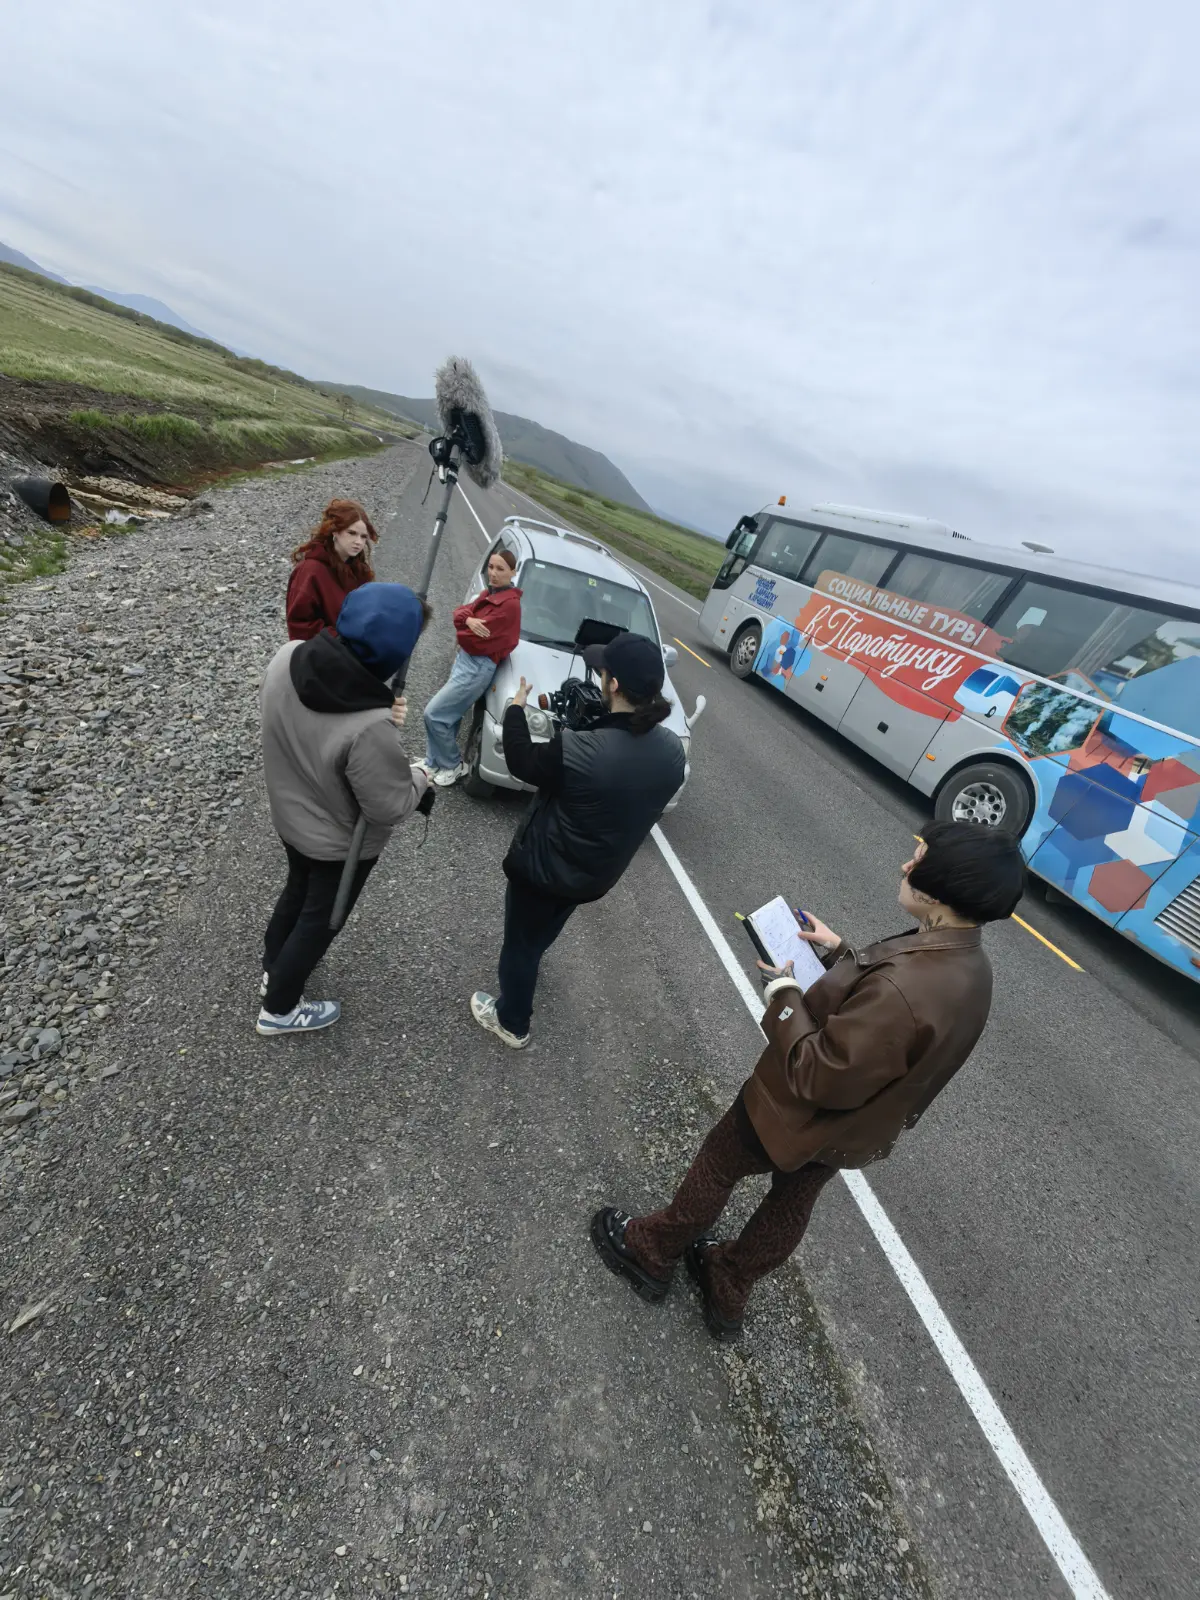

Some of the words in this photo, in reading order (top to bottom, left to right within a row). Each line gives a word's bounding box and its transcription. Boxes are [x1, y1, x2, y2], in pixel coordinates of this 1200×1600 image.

[811, 608, 965, 691] Паратунку
[827, 577, 929, 625] СОЦИАЛЬНЫЕ
[928, 611, 988, 646] ТУРЫ
